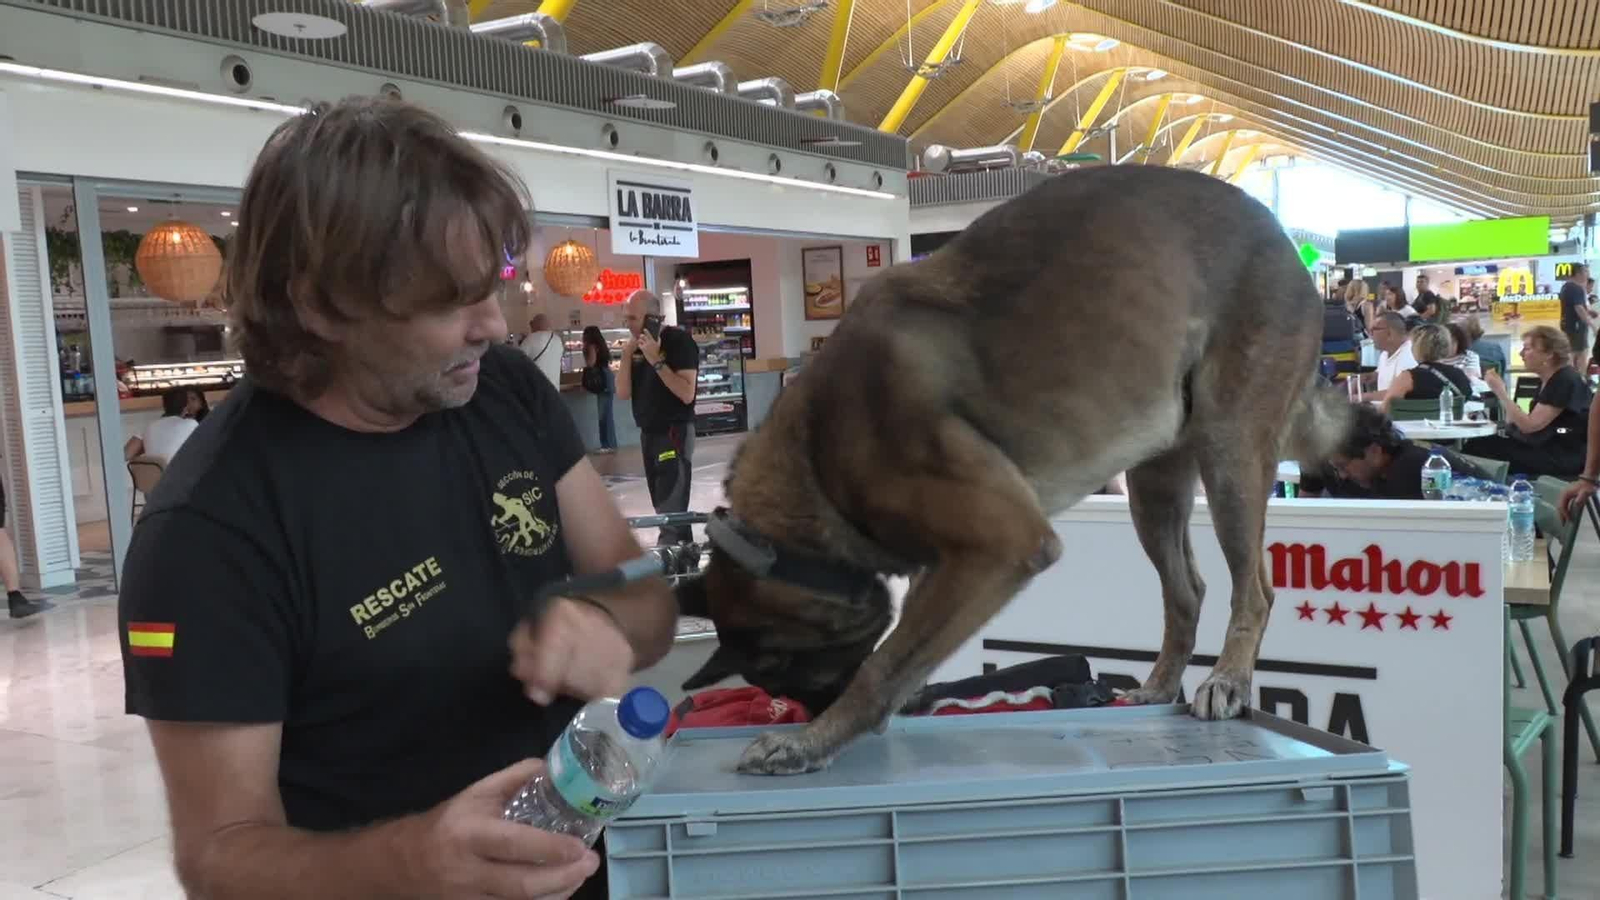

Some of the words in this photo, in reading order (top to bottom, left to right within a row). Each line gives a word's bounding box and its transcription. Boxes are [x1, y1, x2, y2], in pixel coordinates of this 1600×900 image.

[617, 189, 639, 218] LA
[642, 191, 692, 223] BARRA
[350, 556, 442, 624] RESCATE
[1267, 542, 1486, 598] Mahou
